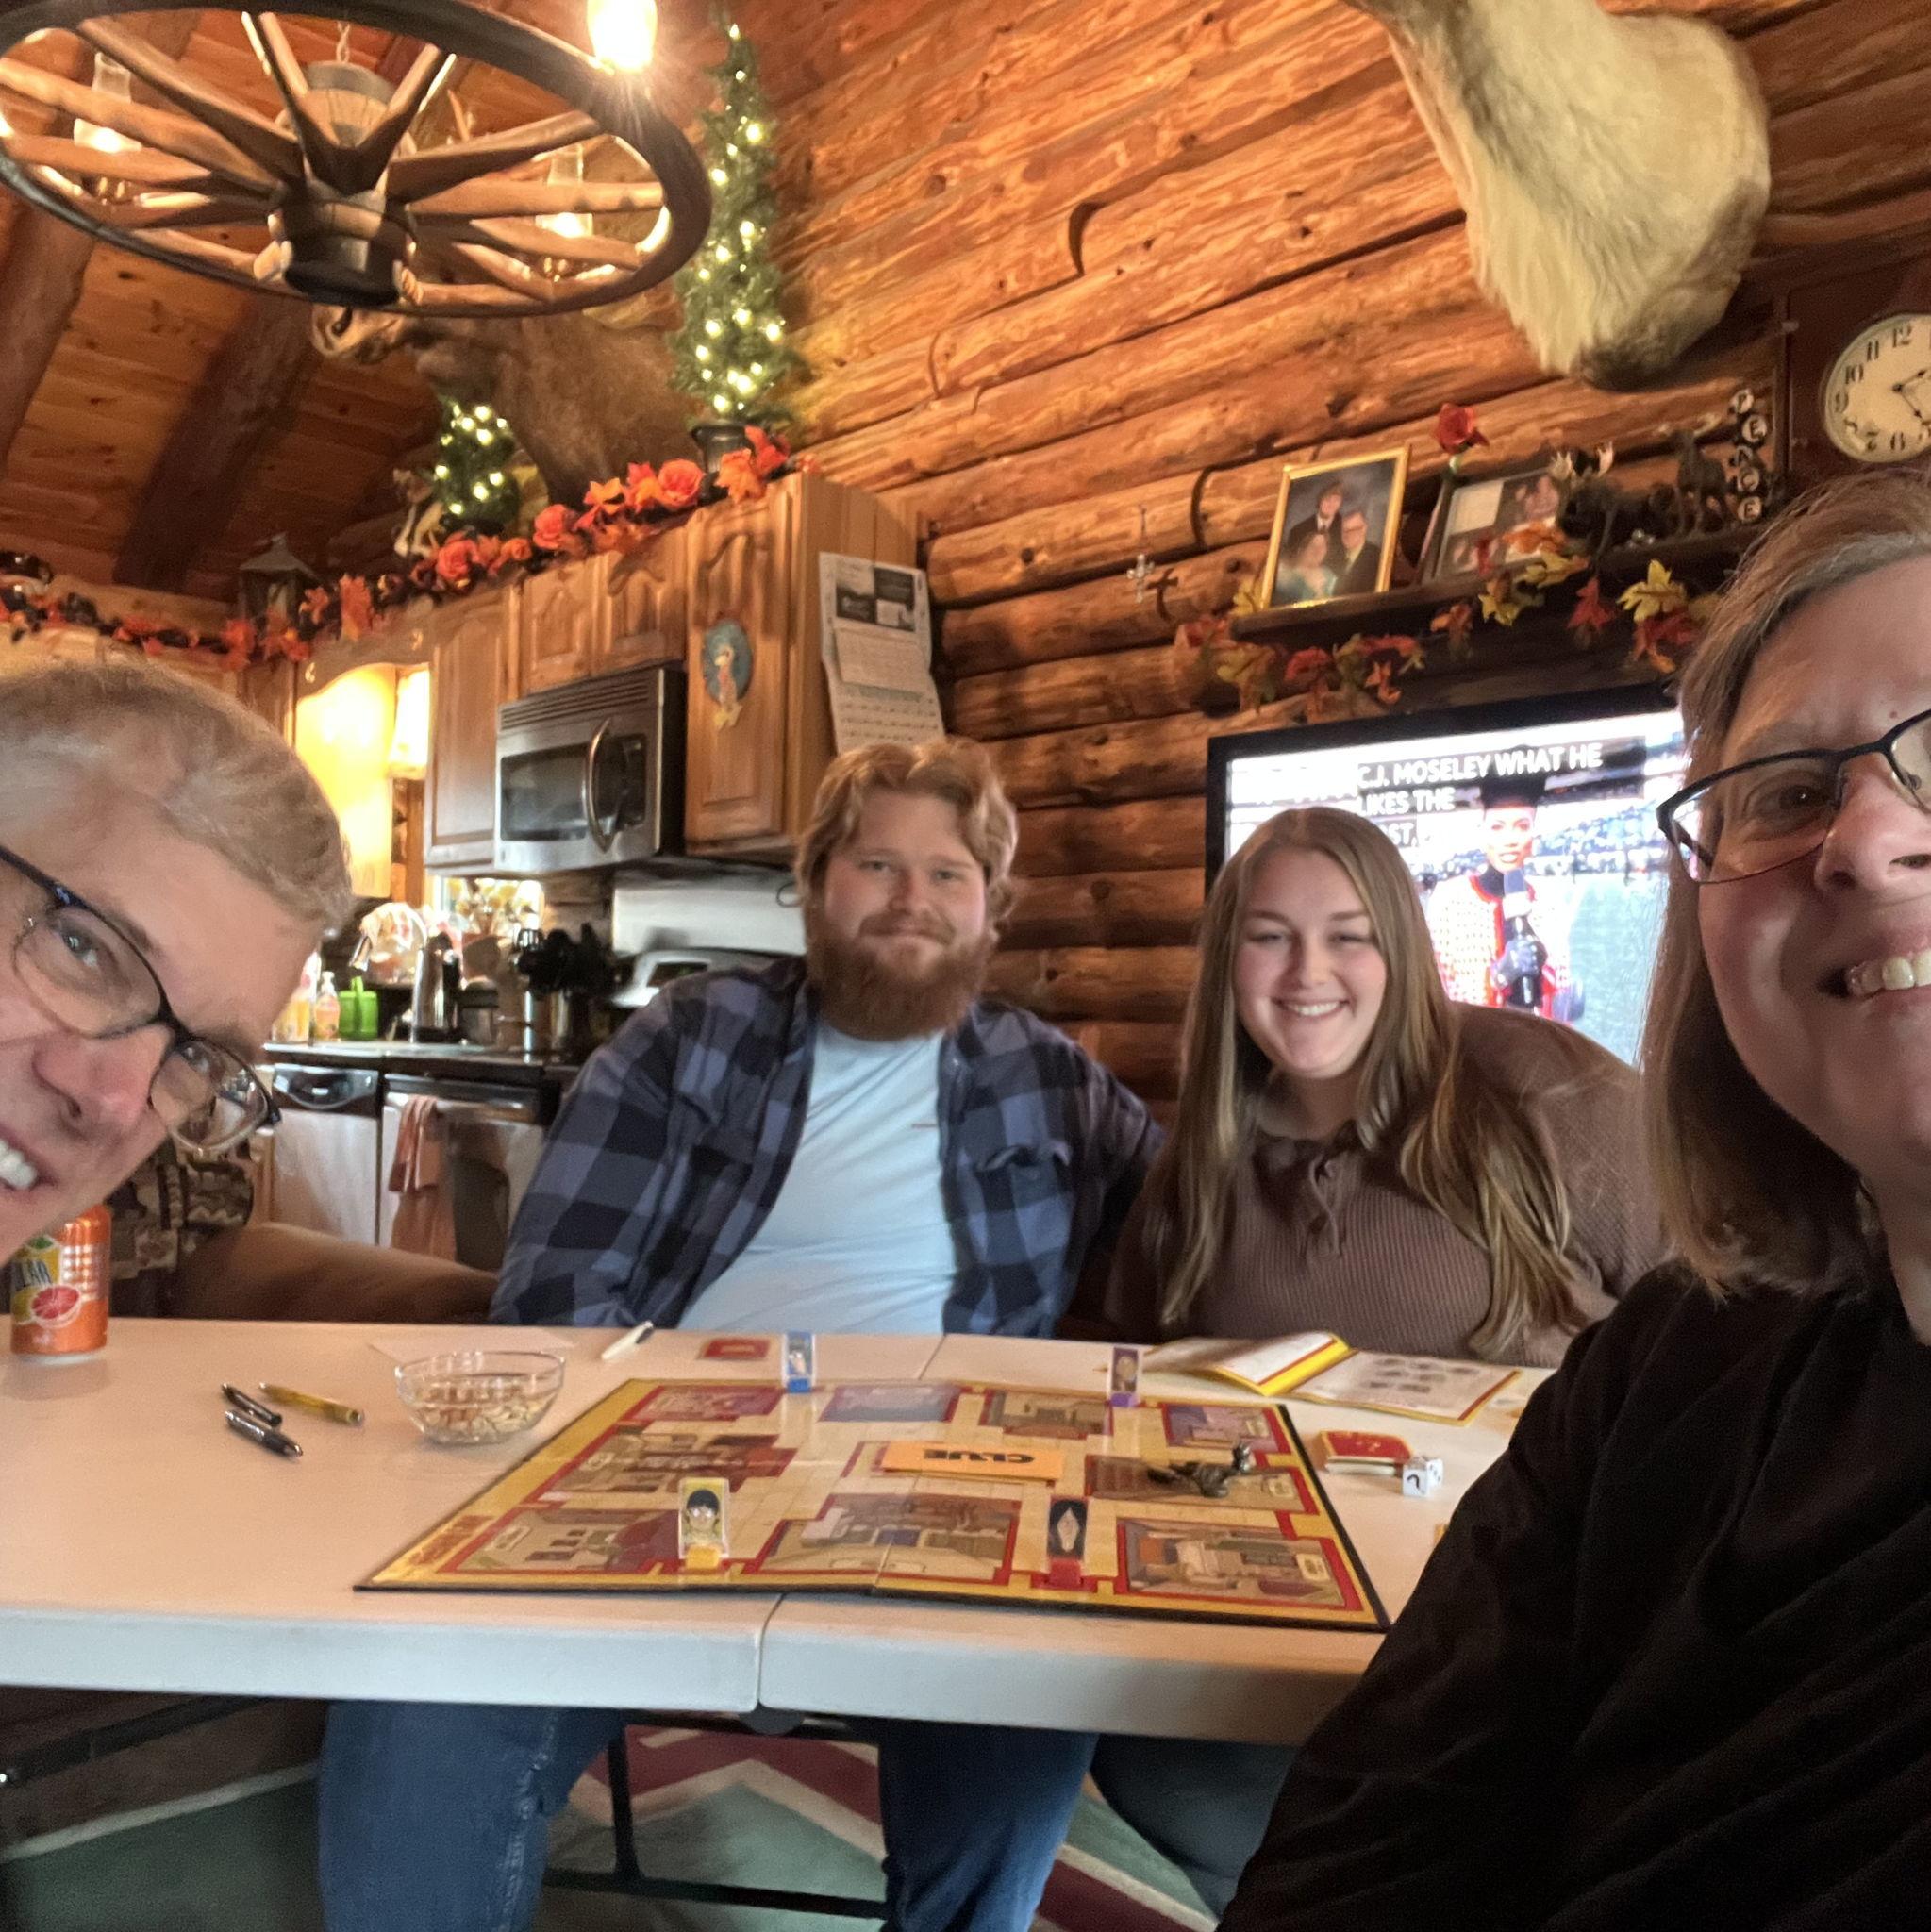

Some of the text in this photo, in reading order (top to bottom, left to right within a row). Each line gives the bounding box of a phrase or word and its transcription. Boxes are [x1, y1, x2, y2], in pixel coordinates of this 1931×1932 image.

[1892, 325, 1911, 347] 12
[1393, 754, 1491, 786] MOSELEY
[1494, 746, 1565, 776] WHAT
[1569, 742, 1604, 770] HE
[1357, 787, 1456, 817] LIKES THE
[924, 1448, 1035, 1464] CLUE
